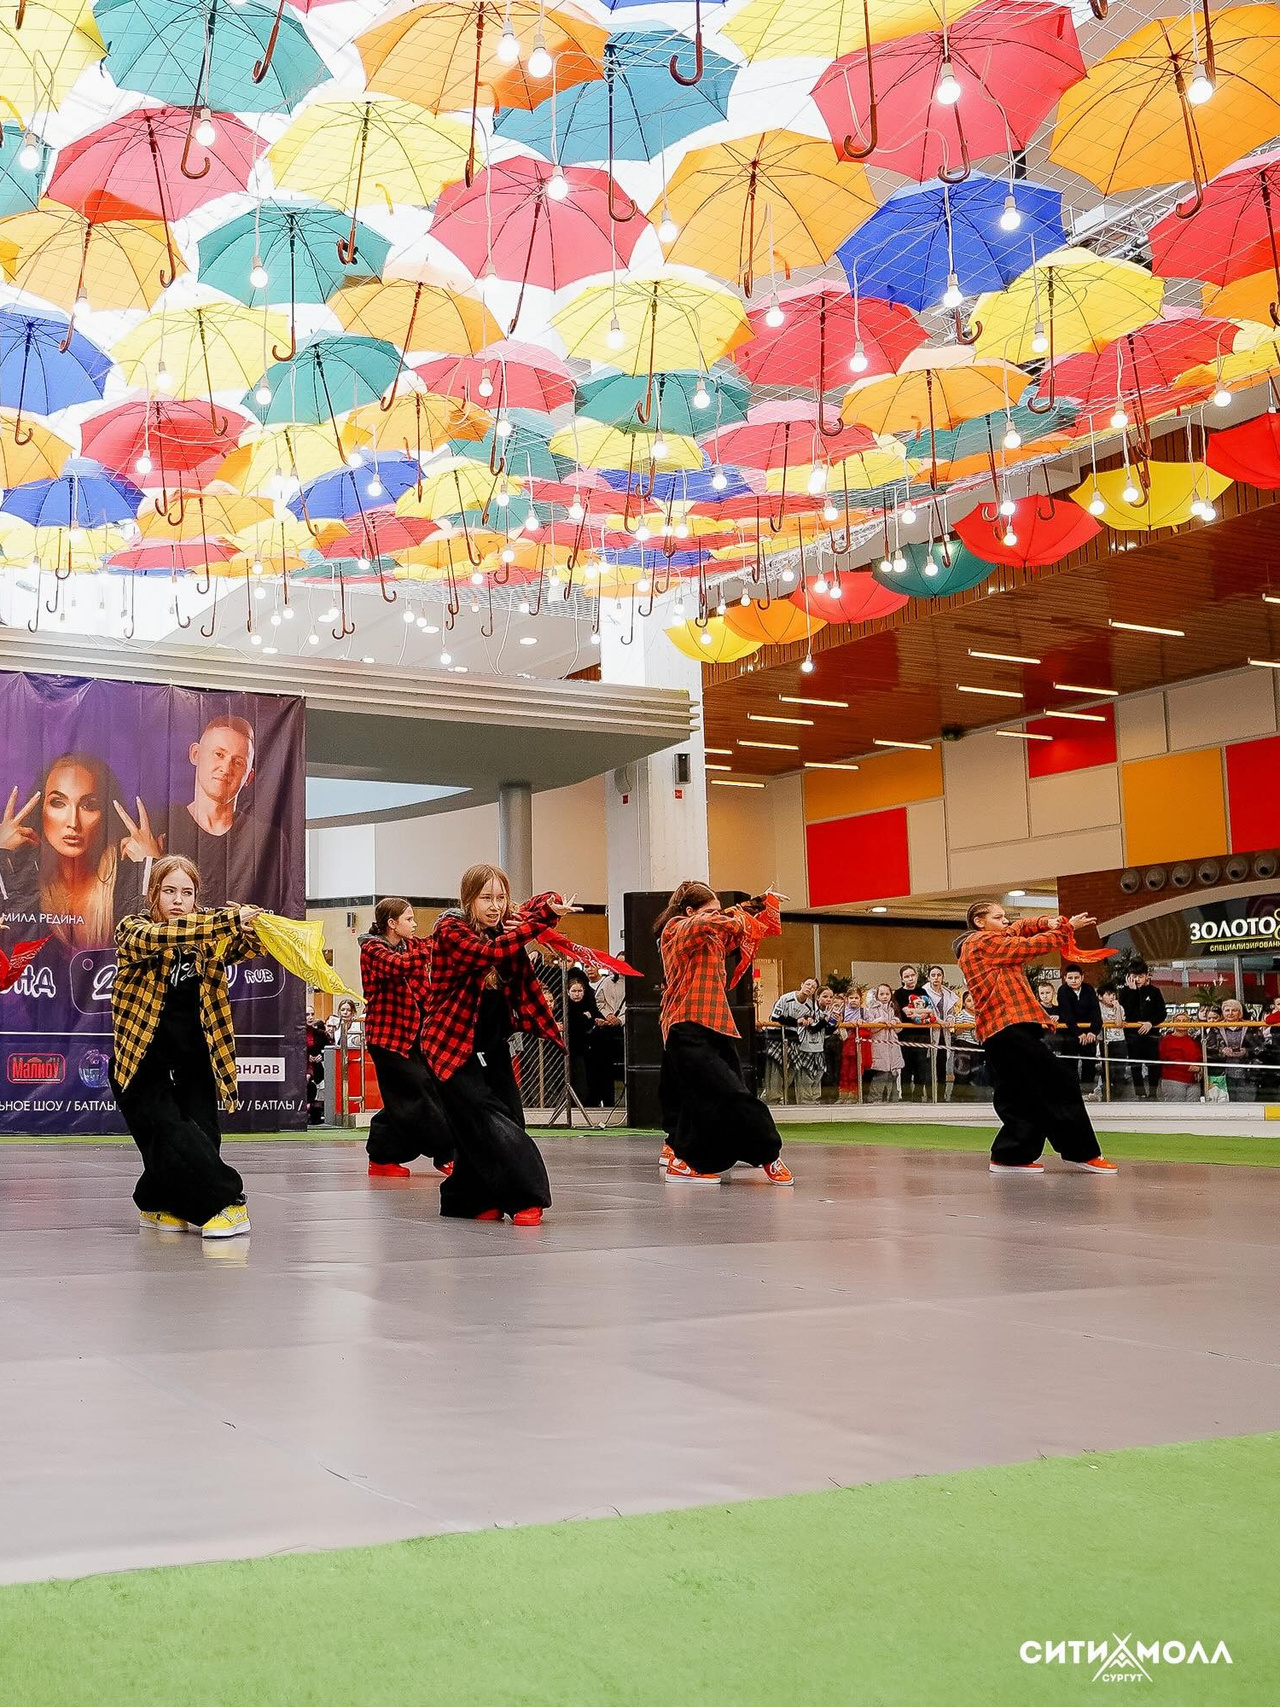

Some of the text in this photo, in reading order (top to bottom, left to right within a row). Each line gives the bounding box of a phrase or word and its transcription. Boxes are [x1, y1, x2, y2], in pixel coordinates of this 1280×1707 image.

[4, 913, 85, 926] МИЛА РЕДИНА
[1189, 916, 1277, 940] ЗОЛОТО
[244, 968, 275, 984] RUB
[236, 1064, 280, 1075] анлав
[33, 1100, 64, 1112] ШОУ
[74, 1100, 117, 1112] БАТТЛЫ
[254, 1100, 295, 1111] БАТТЛЫ
